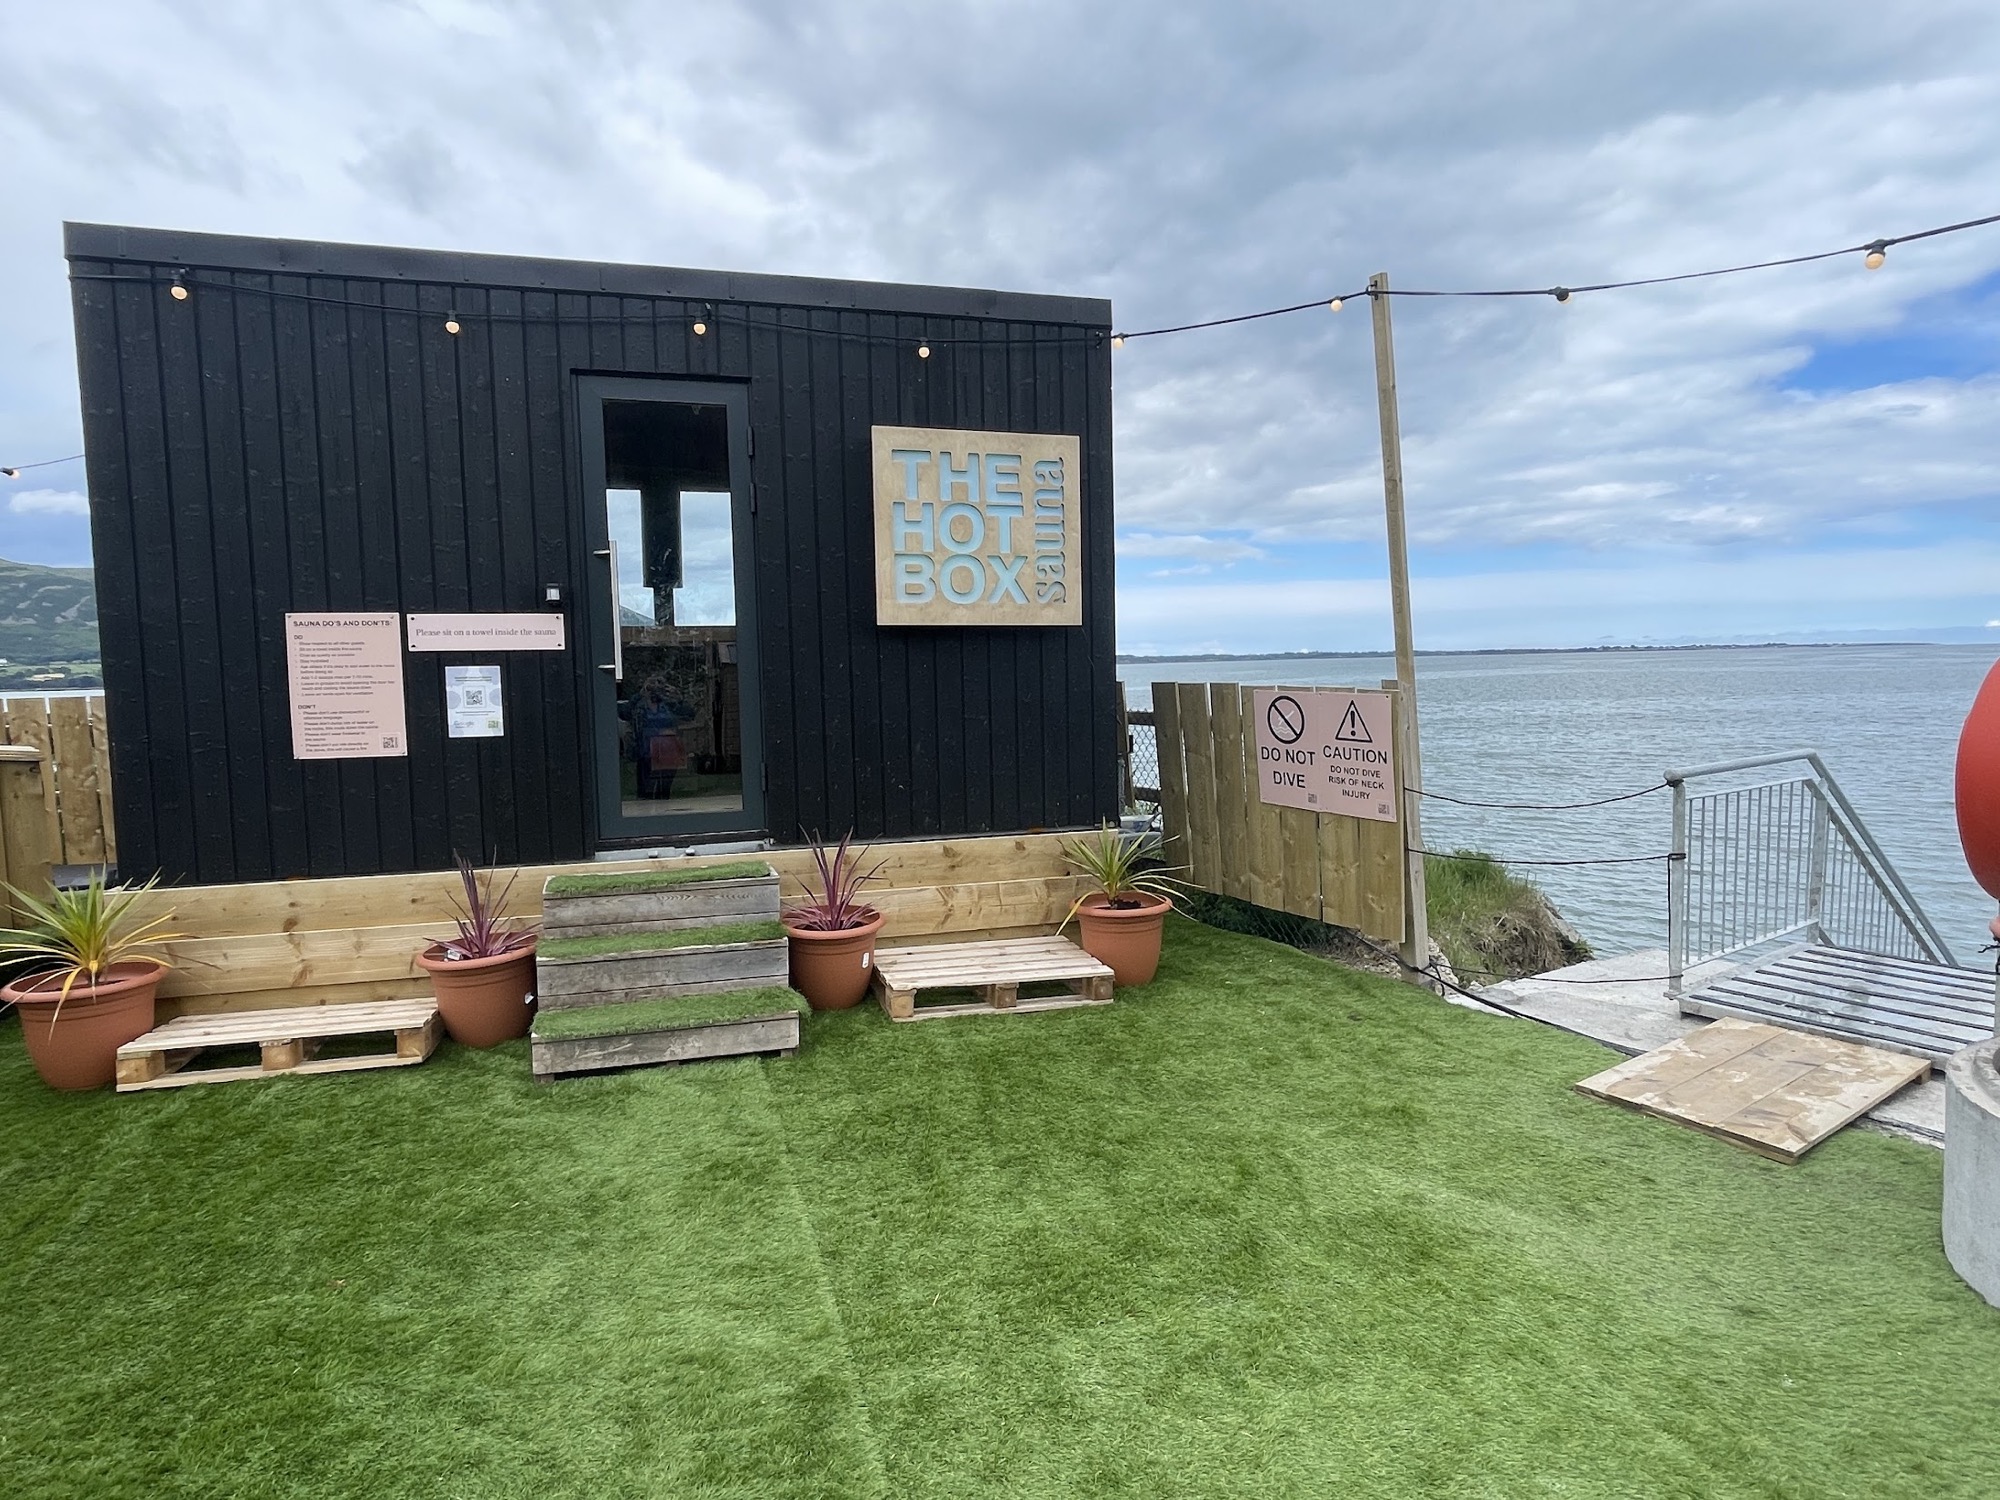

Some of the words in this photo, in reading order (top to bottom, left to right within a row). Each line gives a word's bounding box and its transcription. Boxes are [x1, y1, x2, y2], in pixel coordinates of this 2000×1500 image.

[891, 448, 1023, 503] THE
[892, 501, 1025, 554] HOT
[1033, 457, 1067, 604] sauna
[894, 553, 1030, 605] BOX
[415, 628, 441, 636] Please
[442, 628, 452, 636] sit
[472, 628, 494, 636] towel
[494, 628, 519, 636] inside
[519, 628, 533, 636] the
[1260, 746, 1281, 762] DO
[1285, 749, 1316, 766] NOT
[1322, 745, 1388, 765] CAUTION
[1272, 770, 1306, 788] DIVE
[1330, 765, 1342, 774] DO
[1343, 766, 1360, 776] NOT
[1362, 769, 1381, 779] DIVE
[1328, 776, 1347, 786] RISK
[1348, 778, 1359, 787] OF
[1361, 780, 1385, 790] NECK
[1342, 788, 1371, 800] INJURY
